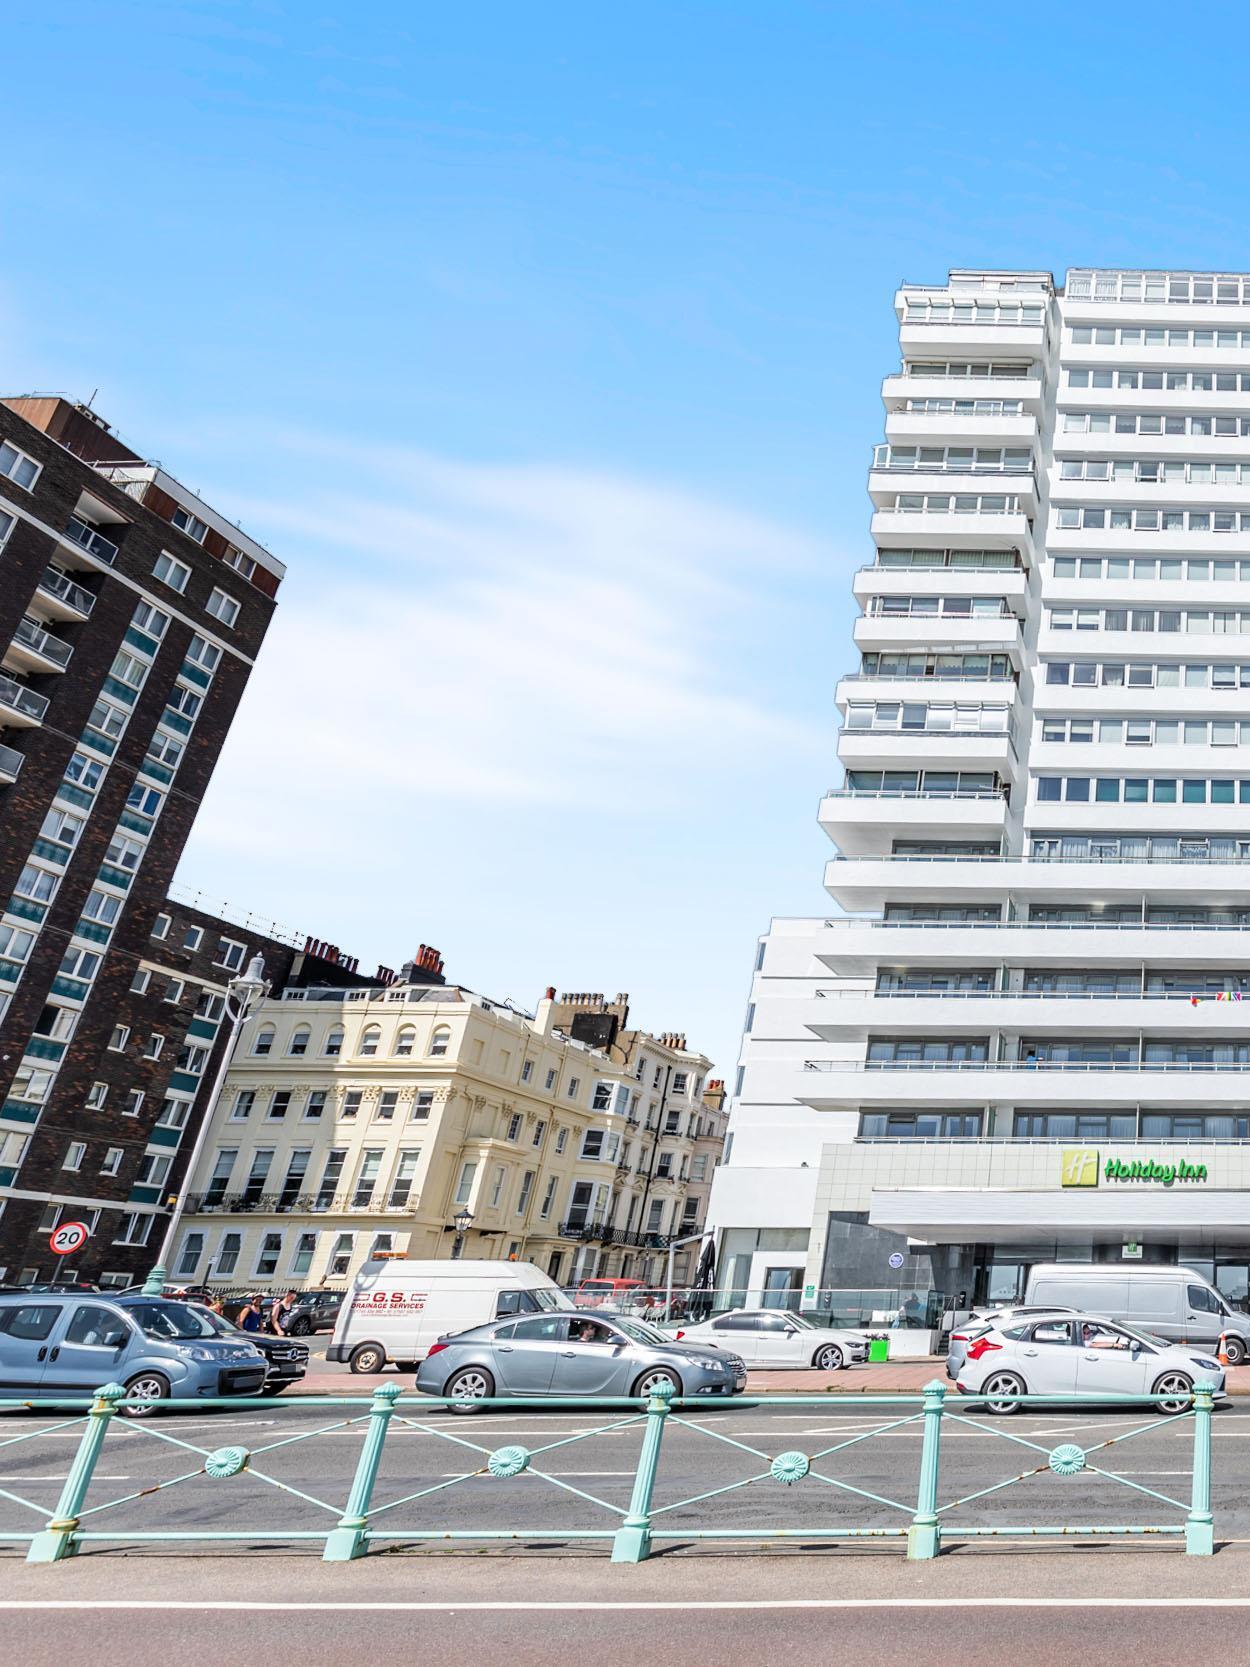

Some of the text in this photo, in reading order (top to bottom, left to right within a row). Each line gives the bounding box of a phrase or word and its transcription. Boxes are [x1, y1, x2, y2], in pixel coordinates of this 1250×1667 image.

[1104, 1158, 1208, 1182] Holiday Inn
[56, 1231, 80, 1244] 20
[373, 1292, 406, 1303] G.S.
